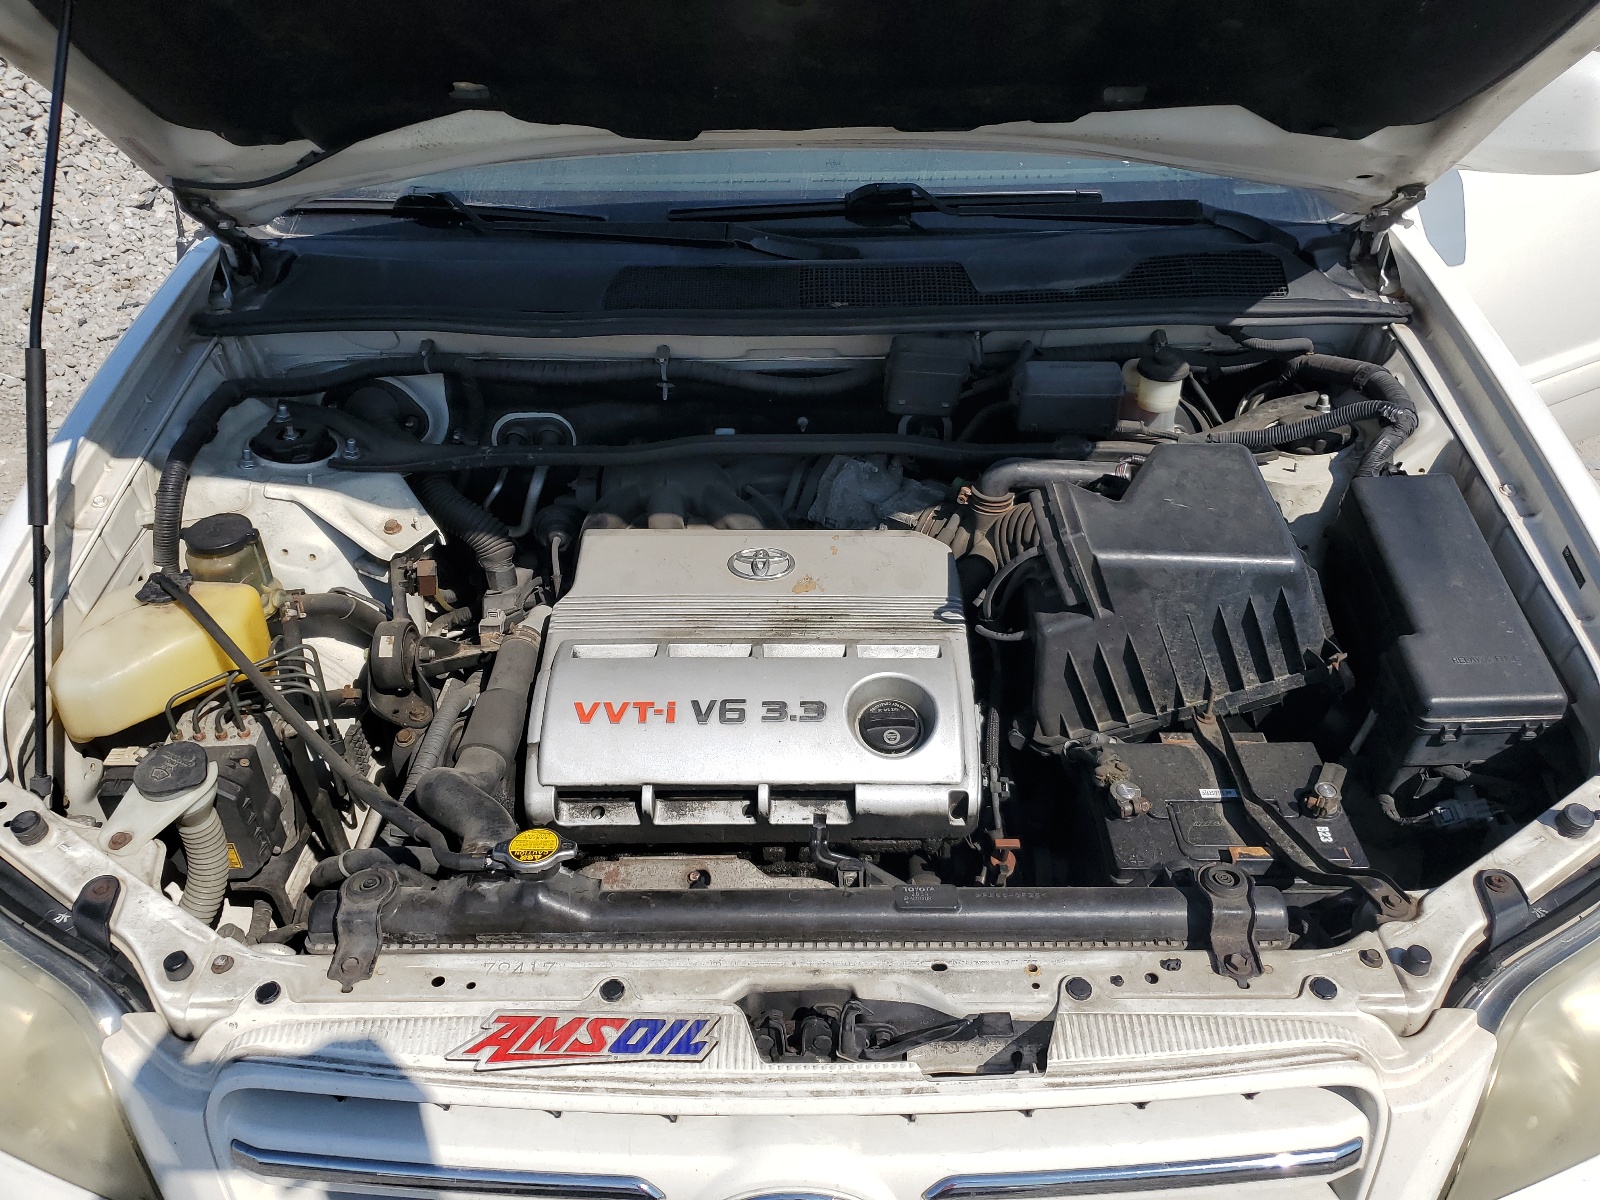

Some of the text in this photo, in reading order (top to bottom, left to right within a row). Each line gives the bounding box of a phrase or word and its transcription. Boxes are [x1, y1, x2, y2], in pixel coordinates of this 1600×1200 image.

[574, 699, 828, 725] VVT-i V6 3.3
[1315, 826, 1334, 843] B23
[462, 1015, 711, 1064] AMSOIL
